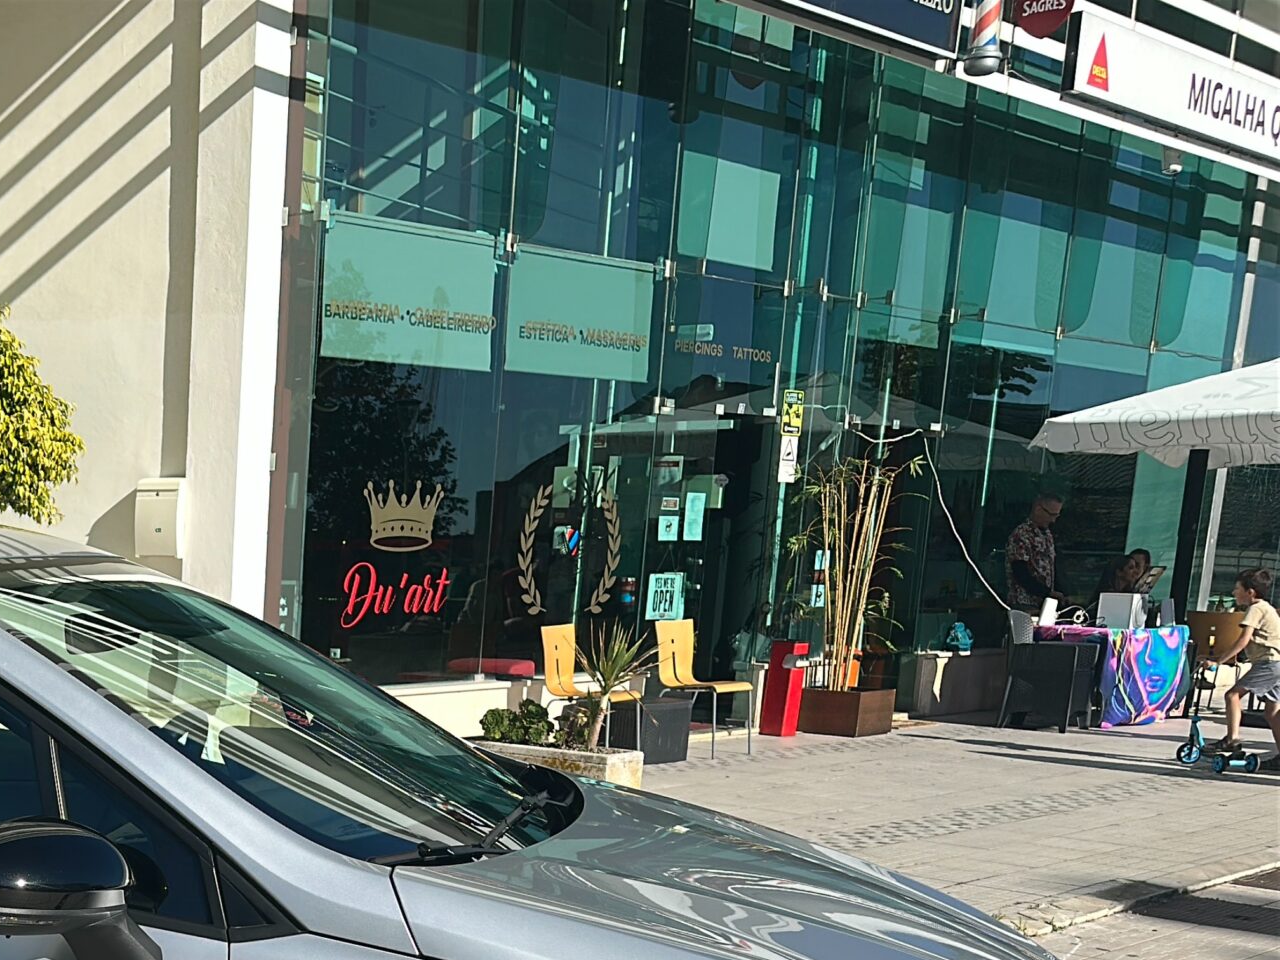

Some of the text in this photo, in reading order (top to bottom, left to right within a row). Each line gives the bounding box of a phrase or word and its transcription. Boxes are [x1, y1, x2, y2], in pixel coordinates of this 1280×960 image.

[1022, 0, 1066, 16] SAGRES
[1187, 73, 1267, 136] MIGALHA
[324, 299, 497, 335] BARBEARIA CABELEIREIRO
[580, 328, 647, 352] MASSAGENS
[675, 340, 772, 363] PIERCINGS TATTOOS
[340, 562, 451, 628] Du'art
[652, 589, 675, 613] OPEN
